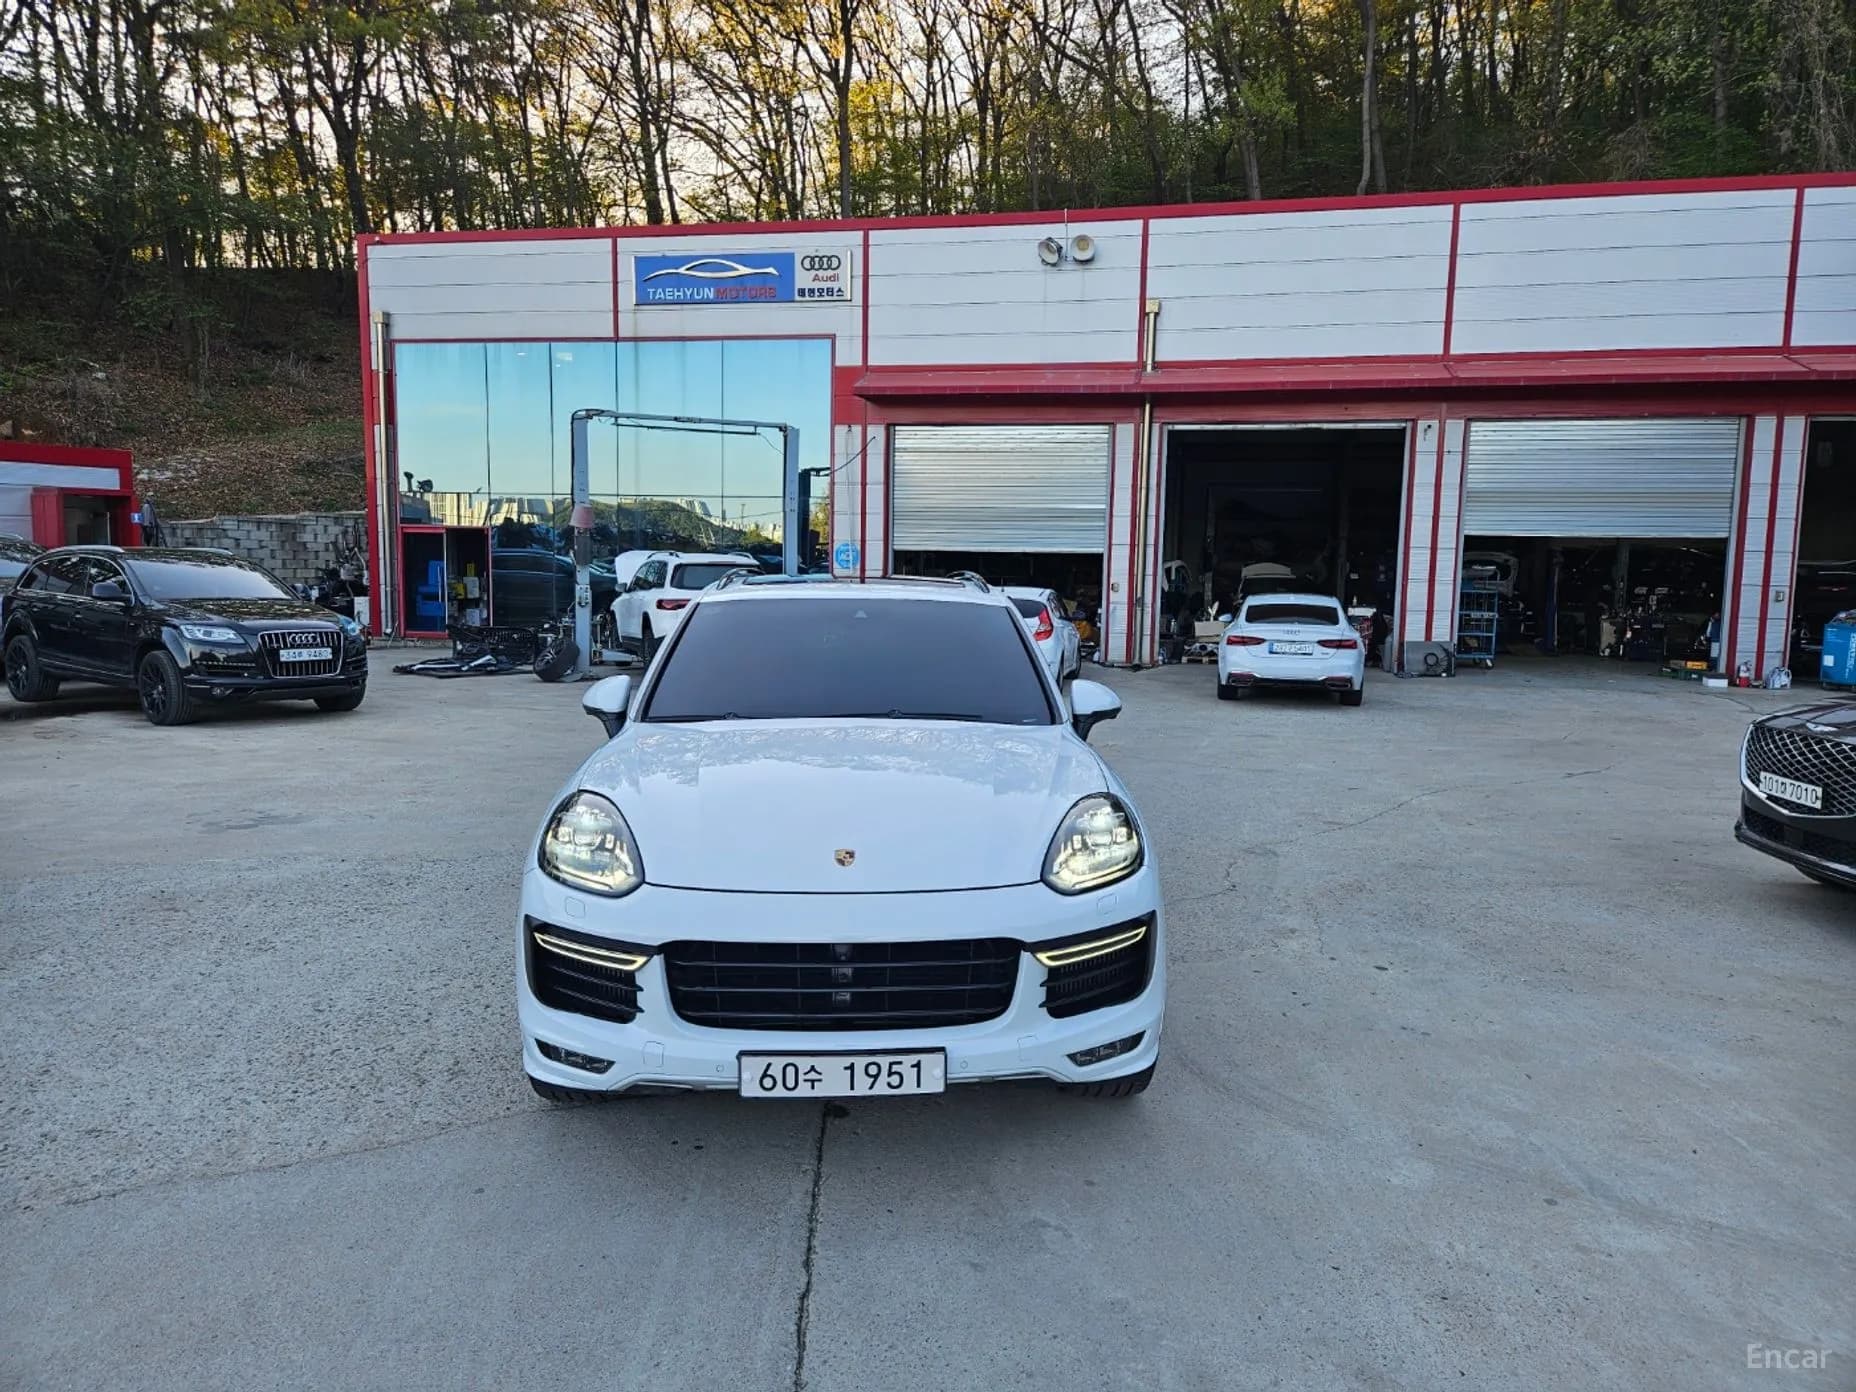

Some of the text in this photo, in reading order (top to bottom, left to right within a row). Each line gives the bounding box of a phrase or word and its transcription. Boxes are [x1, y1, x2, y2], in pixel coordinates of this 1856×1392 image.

[811, 272, 840, 283] Audi
[647, 286, 777, 301] TAEHYUN MOTORS
[1790, 782, 1818, 805] 7010
[758, 1059, 922, 1092] 60수 1951
